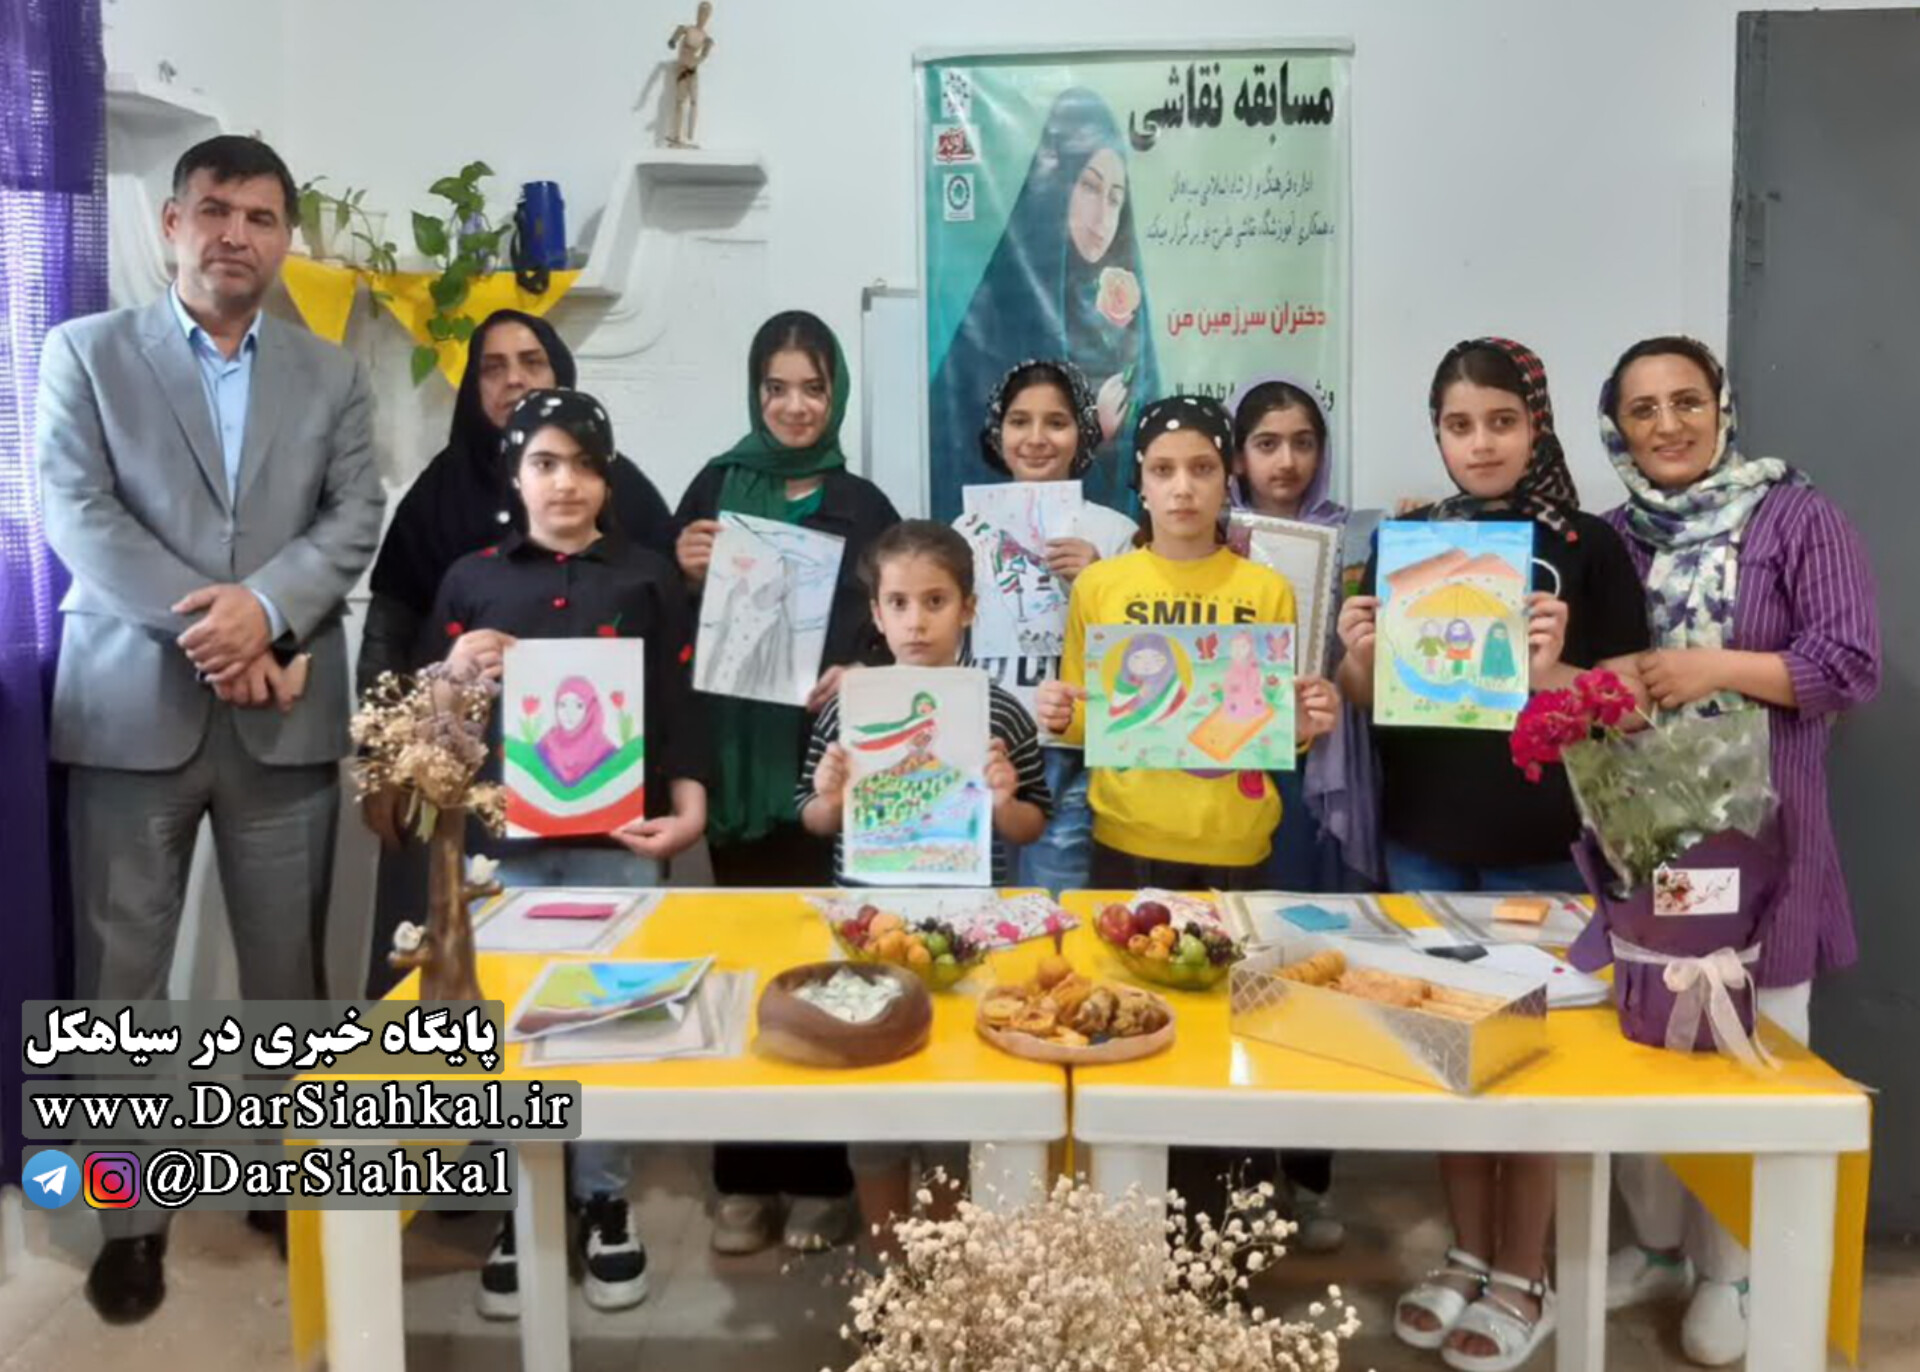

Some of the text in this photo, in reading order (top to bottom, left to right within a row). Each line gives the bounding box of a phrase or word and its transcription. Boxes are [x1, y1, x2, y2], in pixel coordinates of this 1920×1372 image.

[1129, 61, 1334, 151] مسابقه نقاشی
[1167, 301, 1327, 337] دختران سرزمین من
[1124, 600, 1257, 624] SMILE
